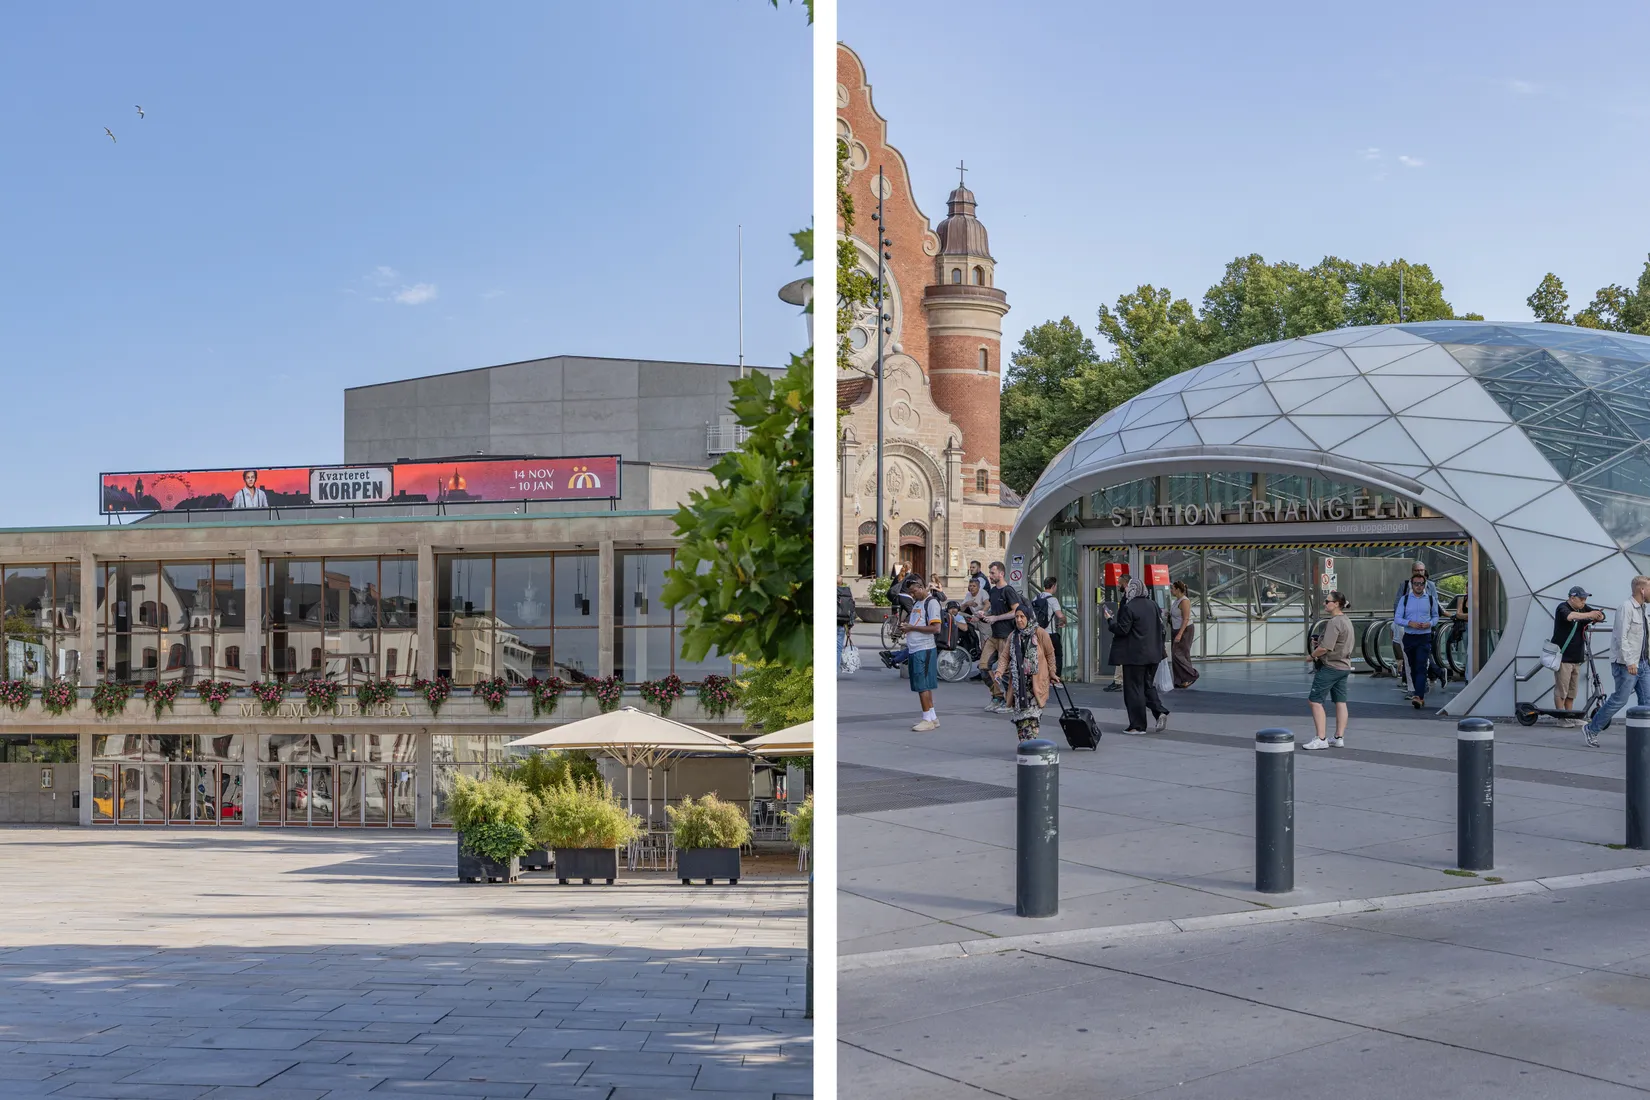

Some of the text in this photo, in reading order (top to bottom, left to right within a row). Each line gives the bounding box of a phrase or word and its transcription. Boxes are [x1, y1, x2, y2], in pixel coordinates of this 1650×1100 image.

[318, 470, 370, 481] Kvarteret
[514, 469, 555, 479] 14 NOV
[318, 481, 383, 500] KORPEN
[519, 481, 531, 491] 10
[532, 481, 554, 492] JAN
[1111, 495, 1412, 527] STATION TRIANGELN
[1336, 523, 1409, 534] norra uppgången
[330, 702, 412, 717] OPERA
